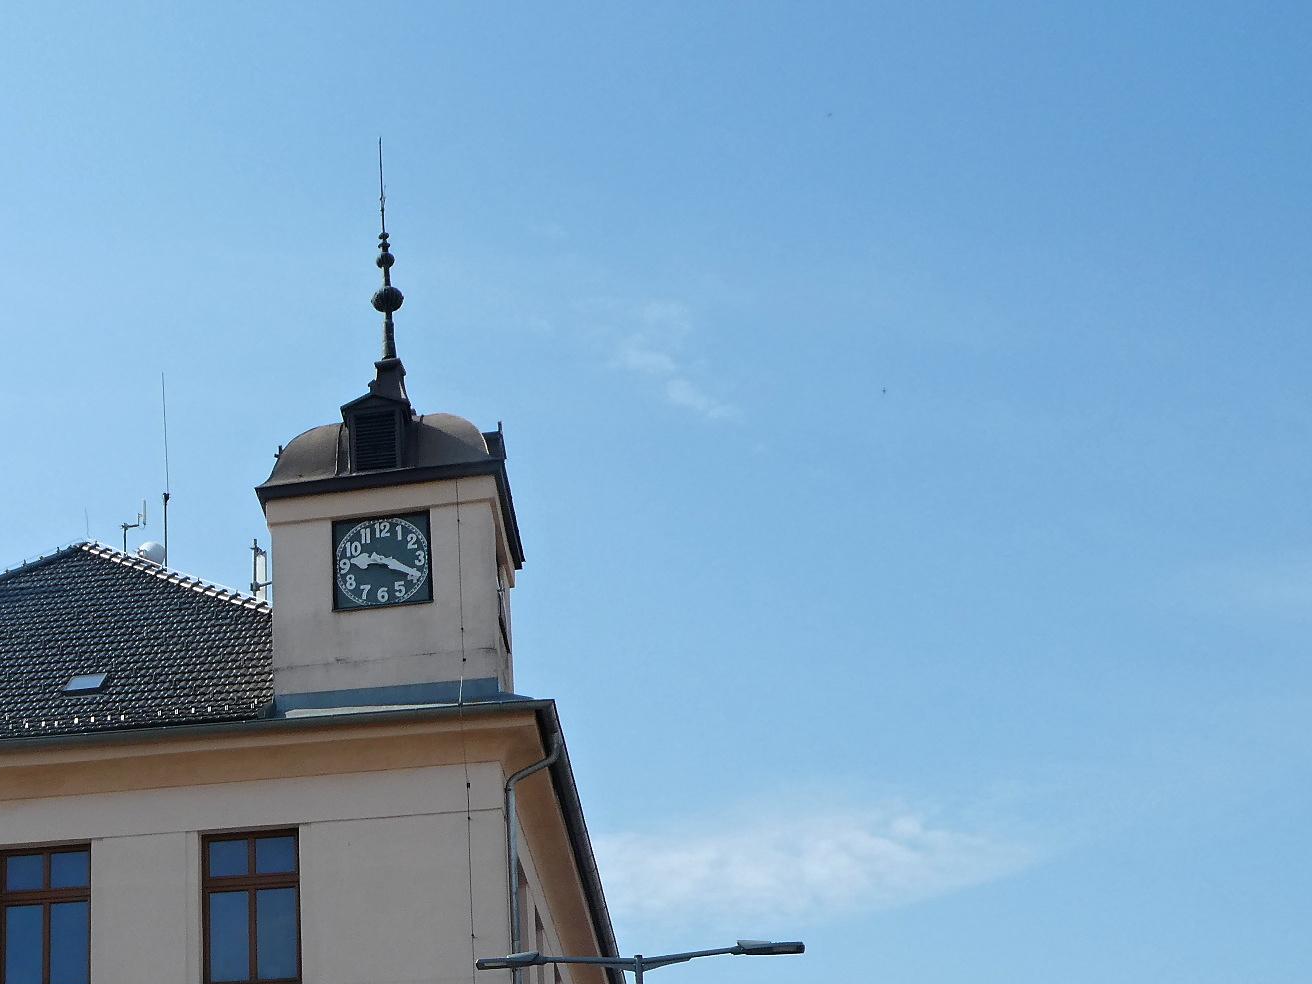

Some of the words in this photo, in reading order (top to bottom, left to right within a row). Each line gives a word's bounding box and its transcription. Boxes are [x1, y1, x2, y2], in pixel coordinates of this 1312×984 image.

[359, 527, 371, 544] 11
[374, 521, 391, 538] 12
[395, 525, 402, 541] 1
[345, 541, 362, 557] 10
[407, 533, 418, 550] 2
[339, 558, 351, 574] 9
[414, 550, 425, 566] 3
[346, 574, 356, 590] 8
[394, 580, 406, 597] 5
[359, 584, 371, 600] 7
[377, 587, 389, 602] 6
